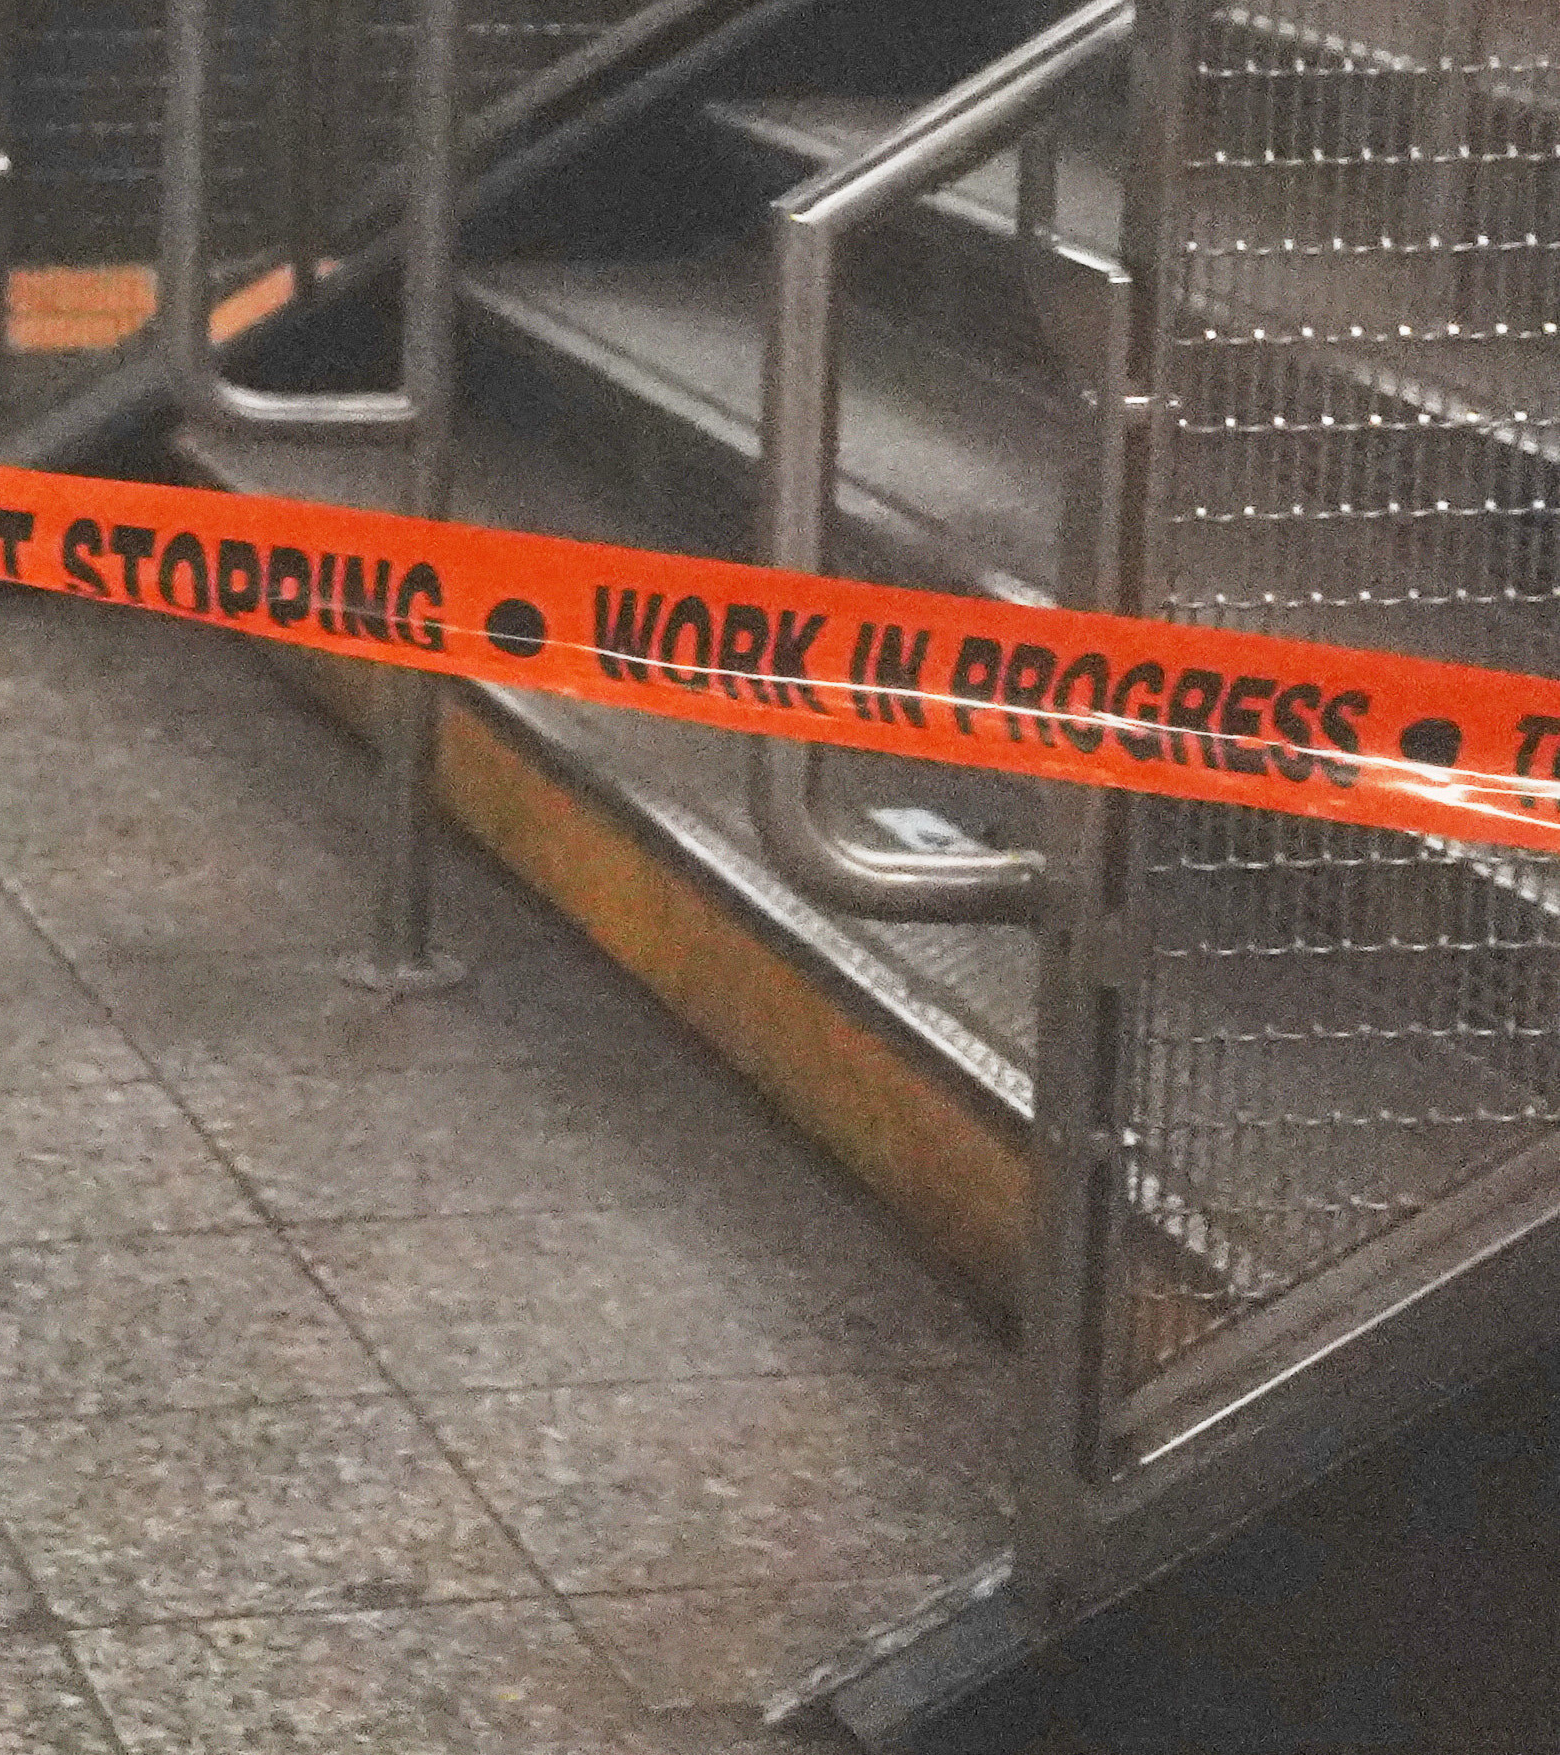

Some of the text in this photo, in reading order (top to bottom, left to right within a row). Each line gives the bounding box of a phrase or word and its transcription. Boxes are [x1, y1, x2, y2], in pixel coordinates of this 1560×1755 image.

[60, 516, 445, 652] STOPPING
[593, 584, 826, 716] WORK
[847, 620, 930, 729] IN
[952, 635, 1372, 790] PROGRESS
